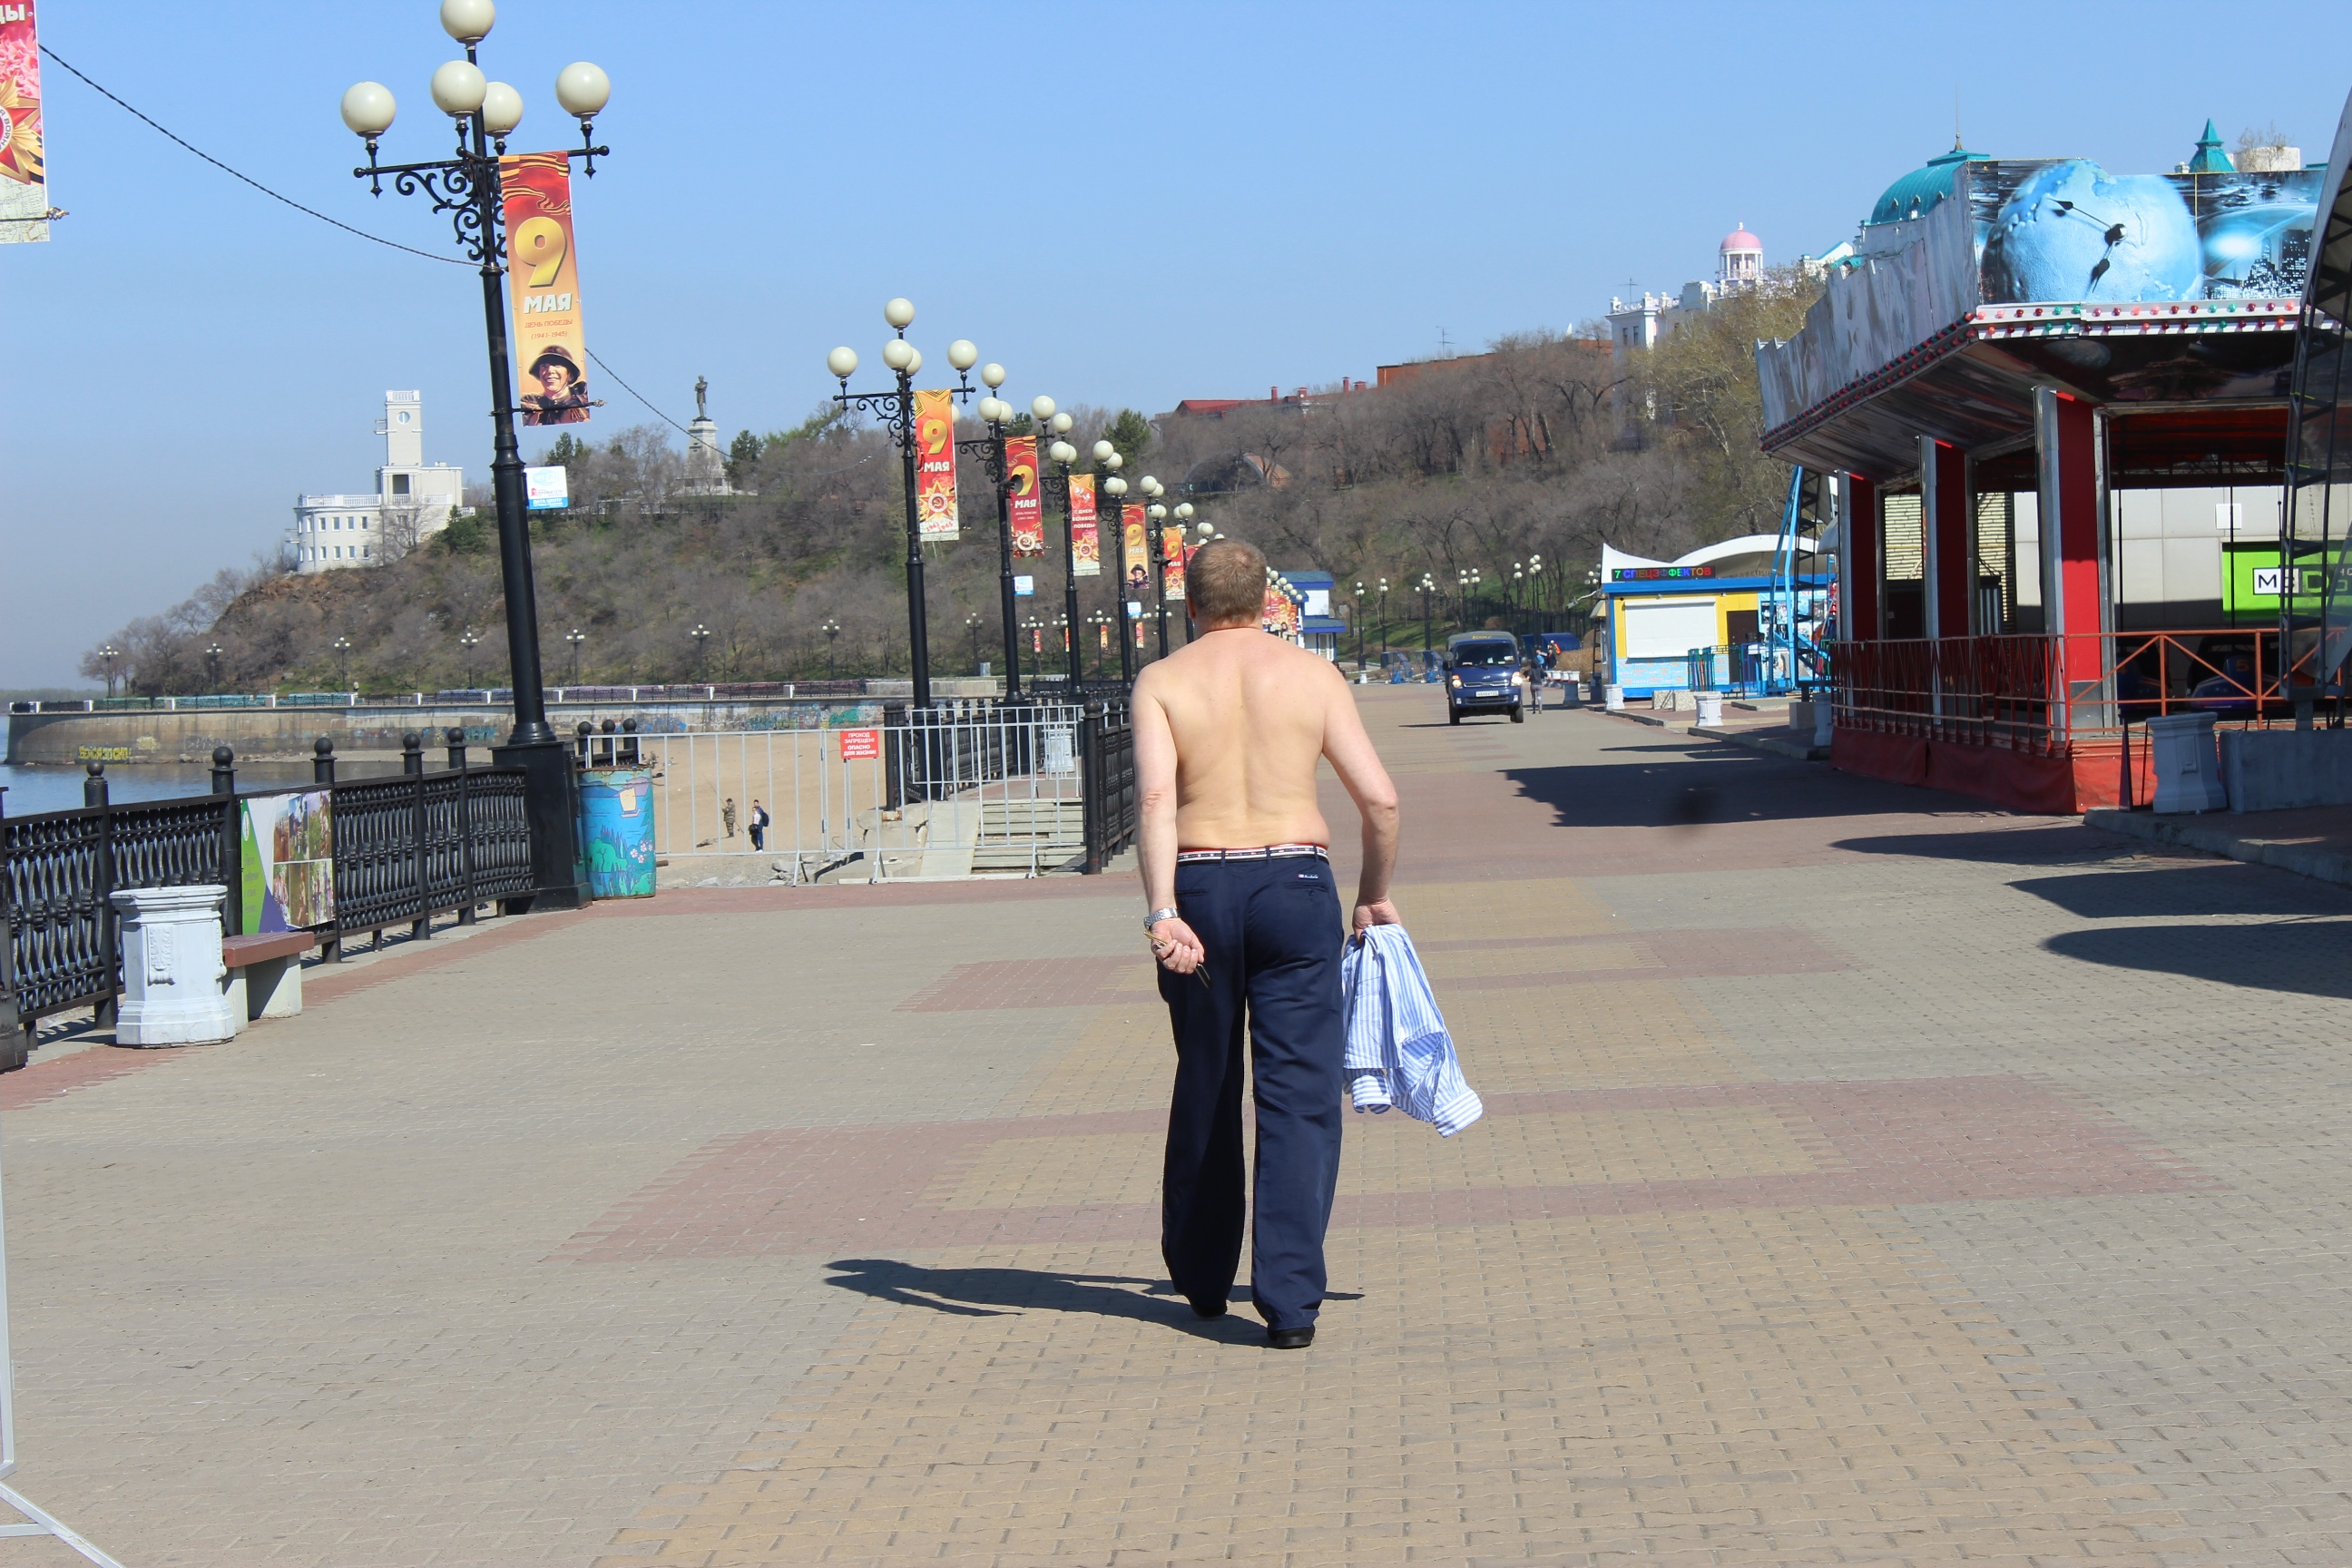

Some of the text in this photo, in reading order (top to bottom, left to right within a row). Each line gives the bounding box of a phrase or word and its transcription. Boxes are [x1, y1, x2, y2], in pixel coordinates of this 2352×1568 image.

[514, 216, 567, 288] 9
[524, 293, 573, 314] МАЯ
[524, 318, 573, 328] ДЕНЬ ПОБЕДЫ
[531, 331, 568, 340] (1941-1945)
[922, 418, 948, 455] 9
[924, 461, 950, 473] МАЯ
[1014, 499, 1037, 509] МАЯ
[1126, 524, 1142, 546] 9
[1167, 541, 1180, 558] 9
[1614, 570, 1621, 579] 7
[2236, 659, 2249, 672] 5
